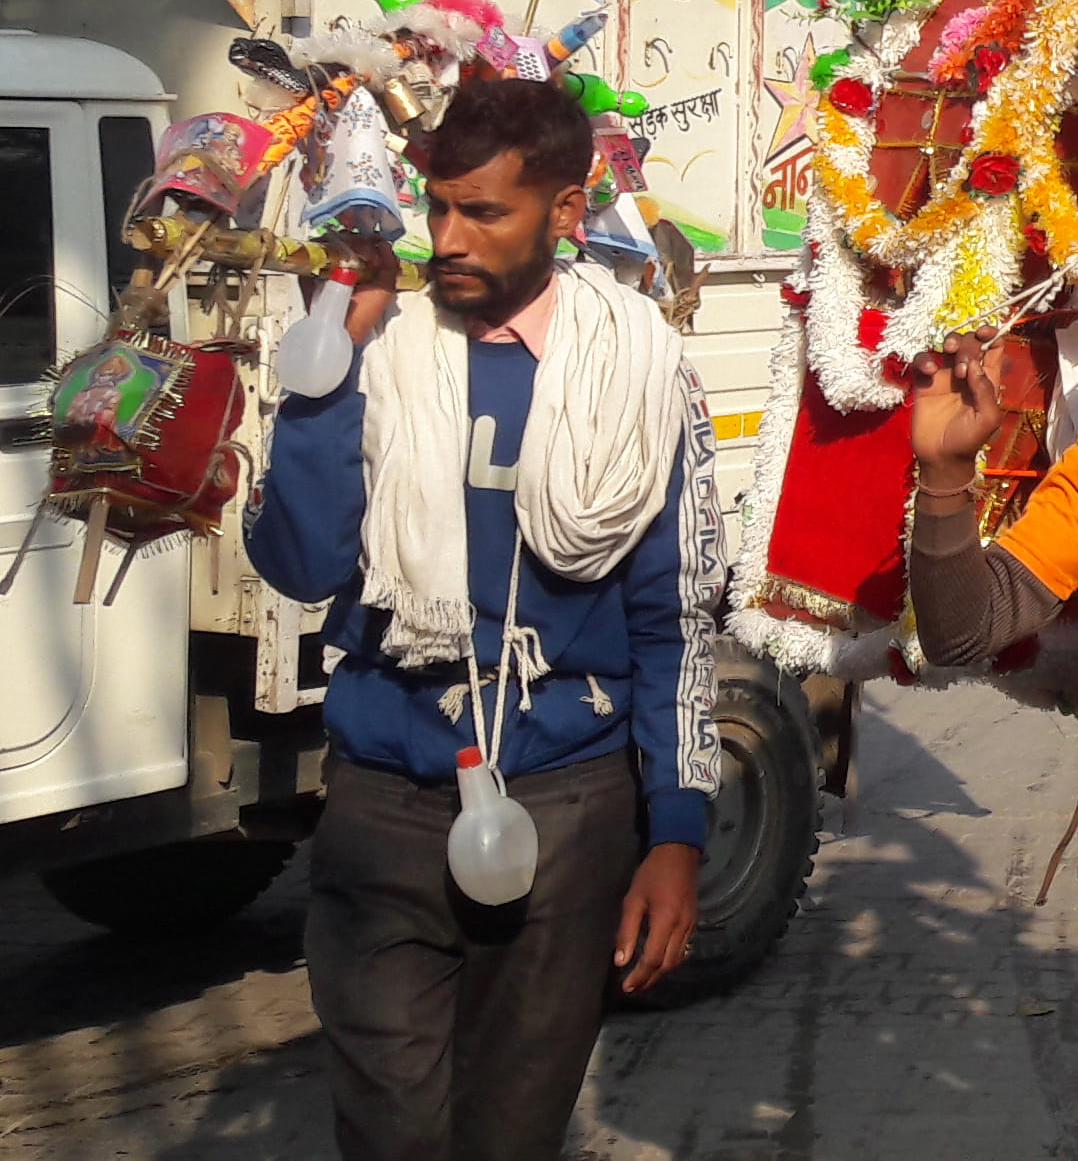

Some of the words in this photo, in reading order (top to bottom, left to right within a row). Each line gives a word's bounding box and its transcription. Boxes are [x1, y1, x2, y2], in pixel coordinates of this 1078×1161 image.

[628, 105, 668, 140] सड़क
[670, 87, 722, 132] सुरक्षा
[690, 399, 716, 468] FILA
[700, 506, 718, 576] FILA
